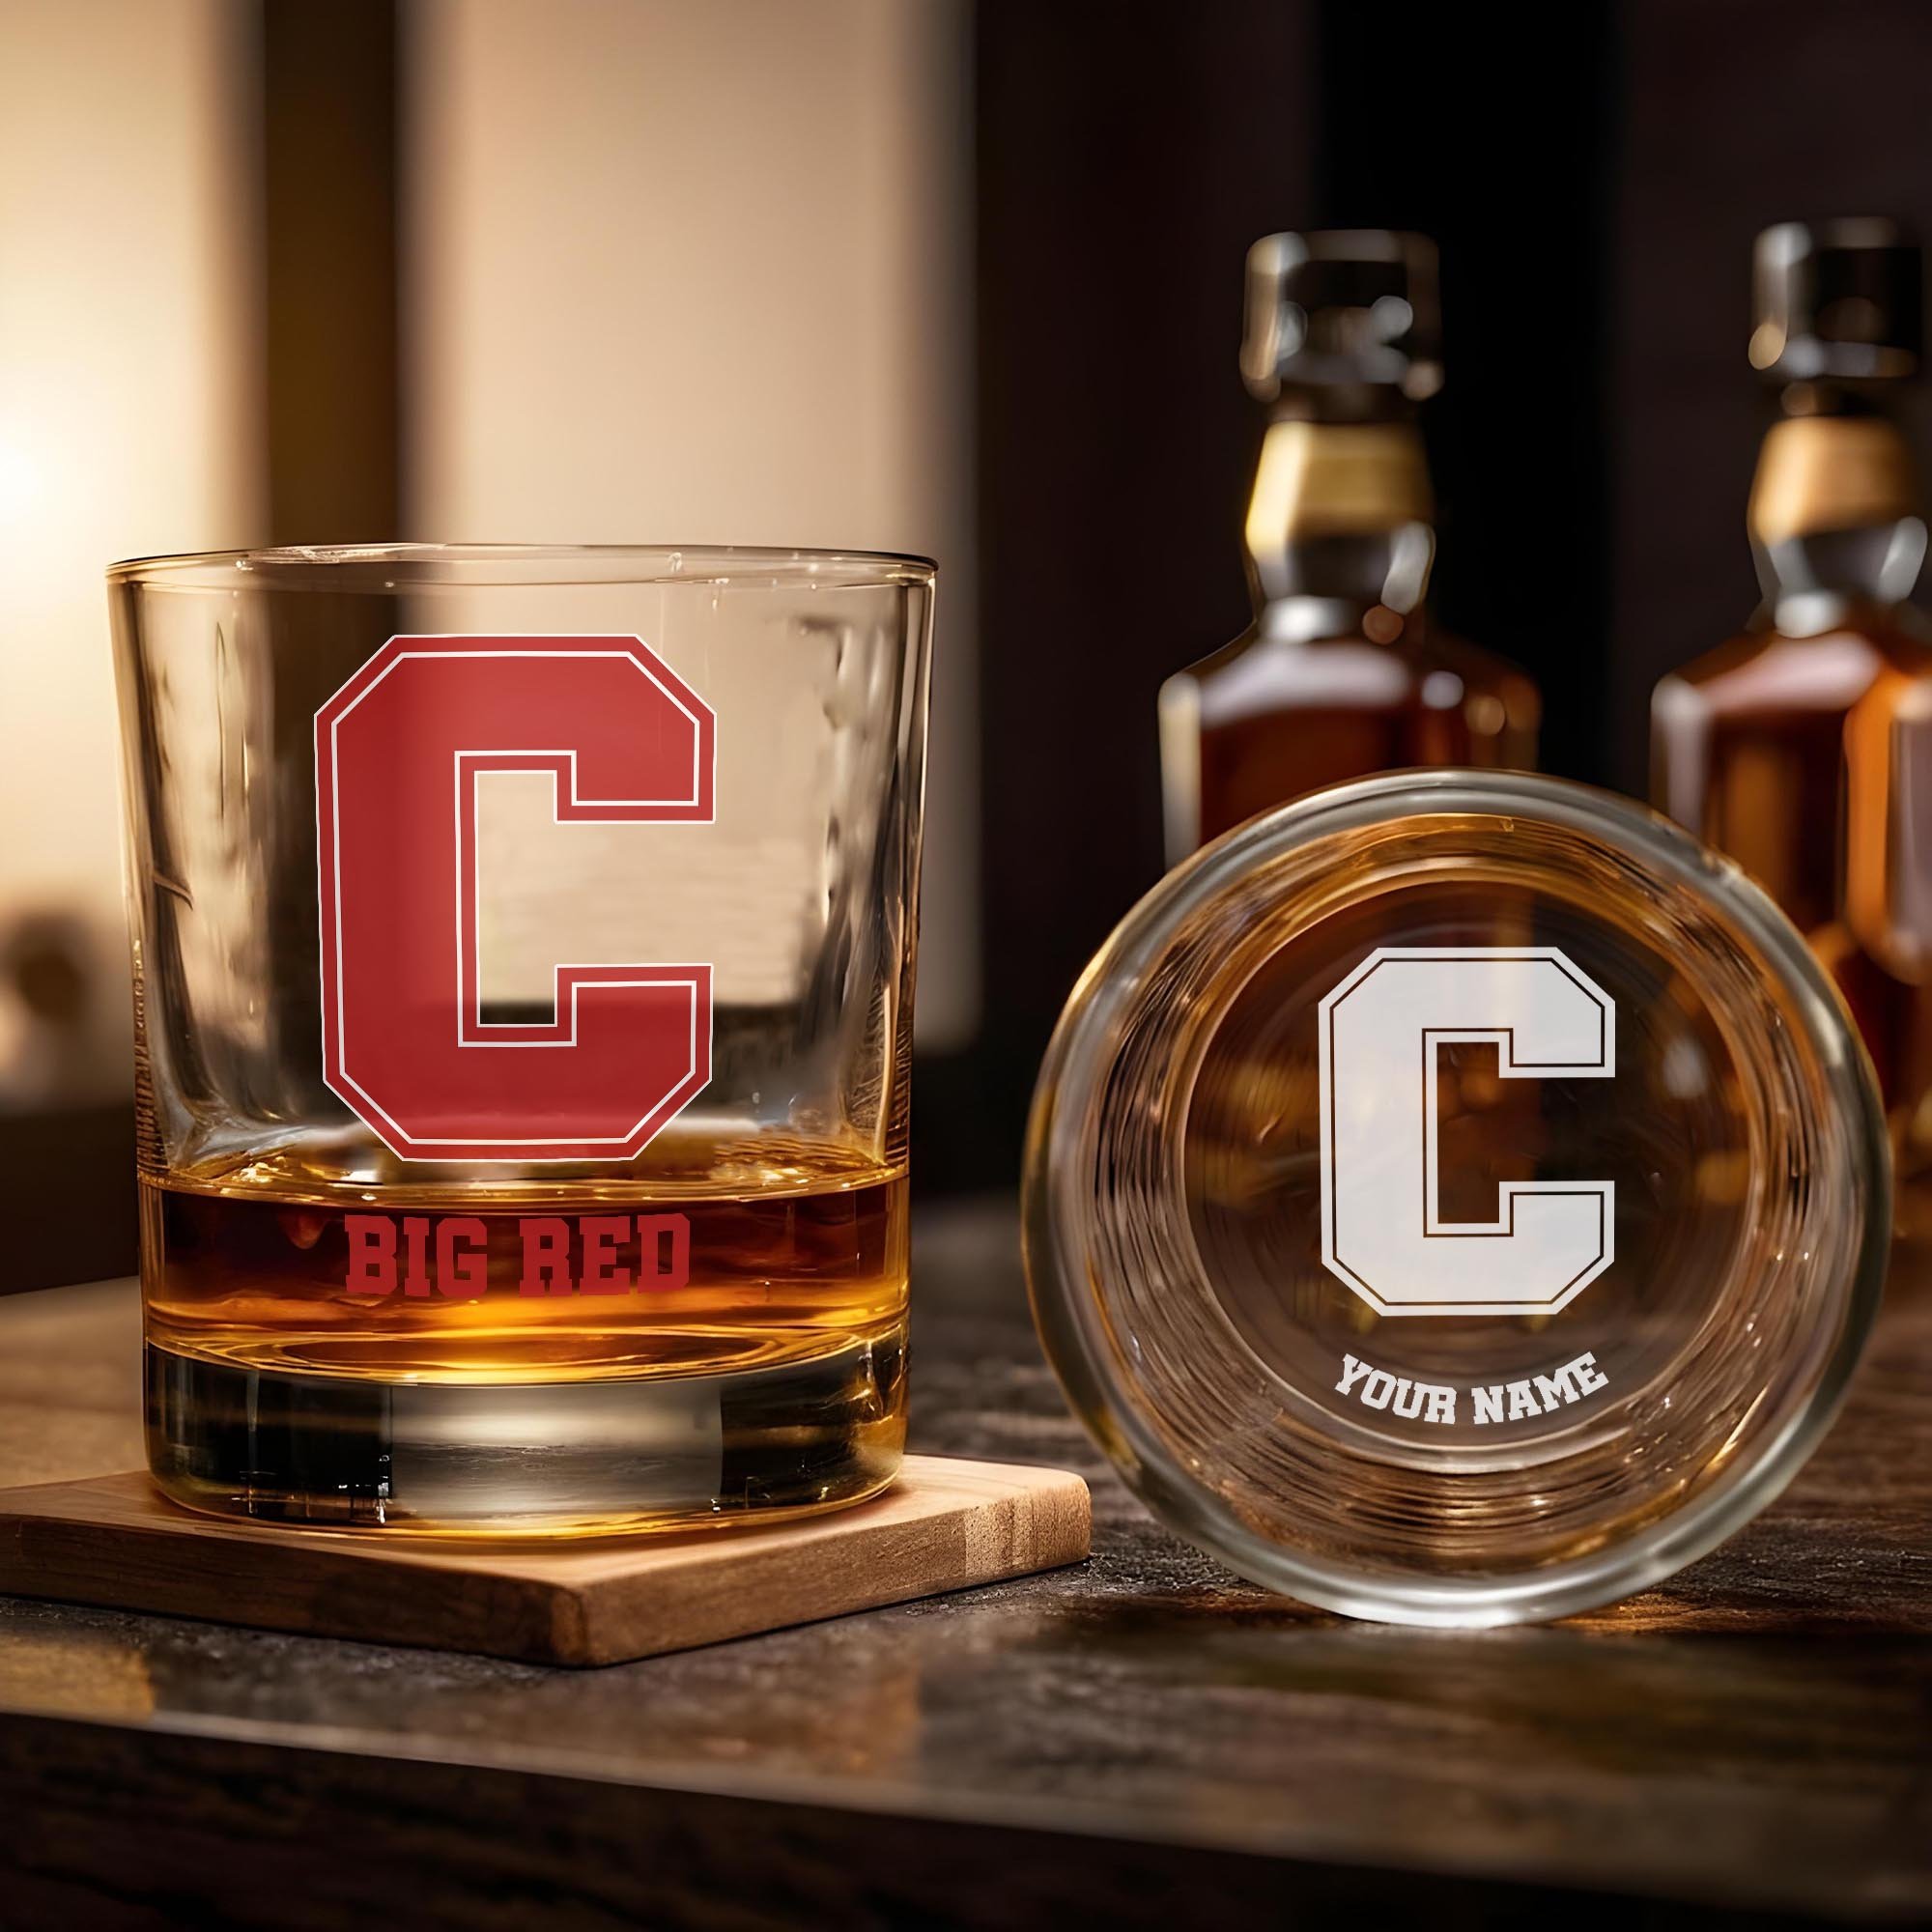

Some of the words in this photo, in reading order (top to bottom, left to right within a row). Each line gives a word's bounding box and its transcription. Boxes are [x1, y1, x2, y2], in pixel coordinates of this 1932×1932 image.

[314, 634, 717, 1162] C
[1318, 947, 1615, 1317] C
[345, 1213, 488, 1298] BIG
[519, 1212, 691, 1297] RED
[1334, 1352, 1458, 1425] YOUR
[1471, 1350, 1609, 1425] NAME
